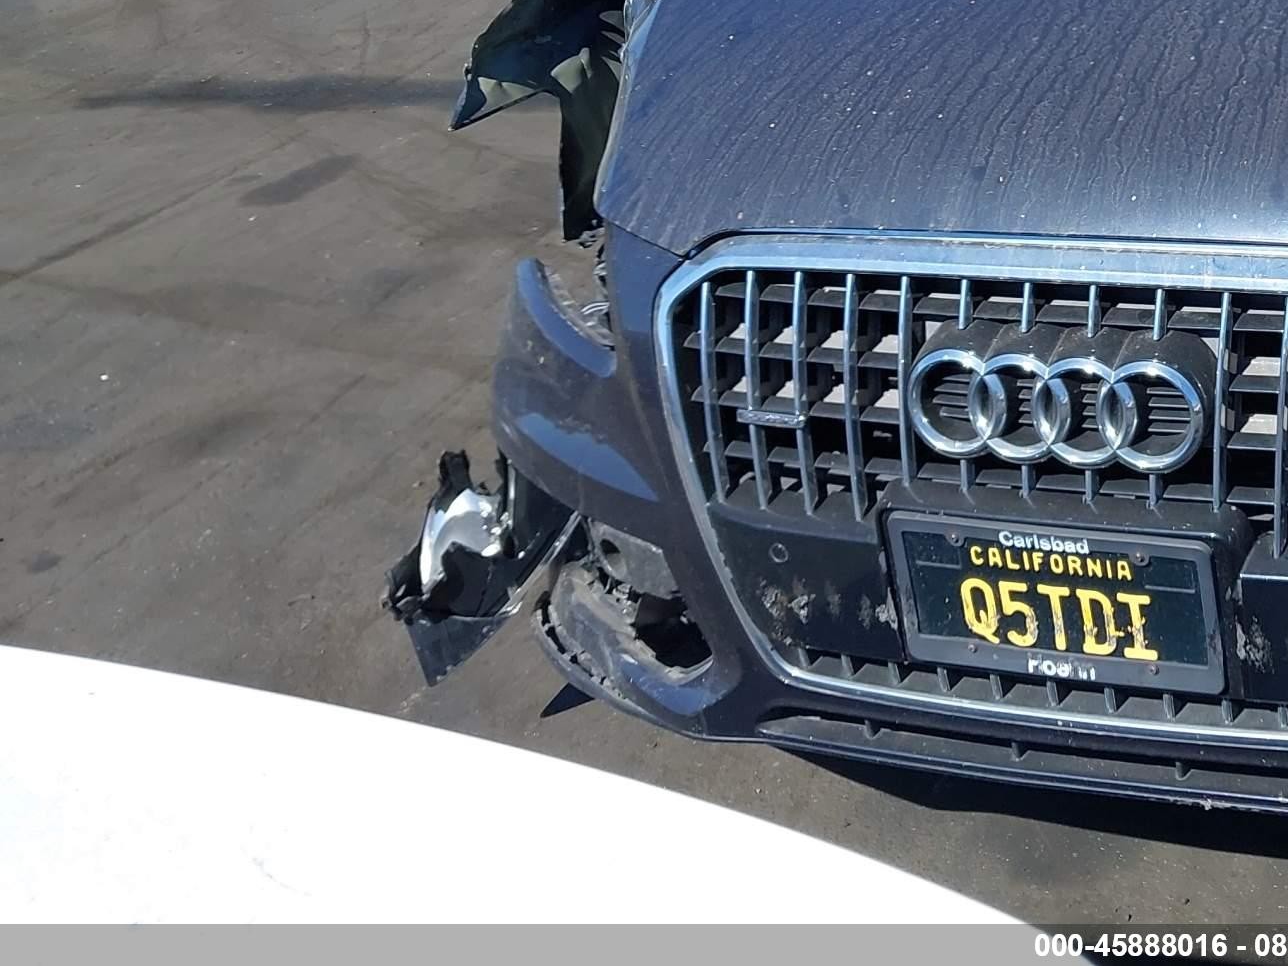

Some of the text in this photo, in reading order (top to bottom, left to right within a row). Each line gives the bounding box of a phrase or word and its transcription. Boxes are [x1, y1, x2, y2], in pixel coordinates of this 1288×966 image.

[998, 530, 1090, 555] Carlsbad
[969, 545, 1133, 581] CALIFORNIA
[960, 577, 1159, 661] Q5TDI
